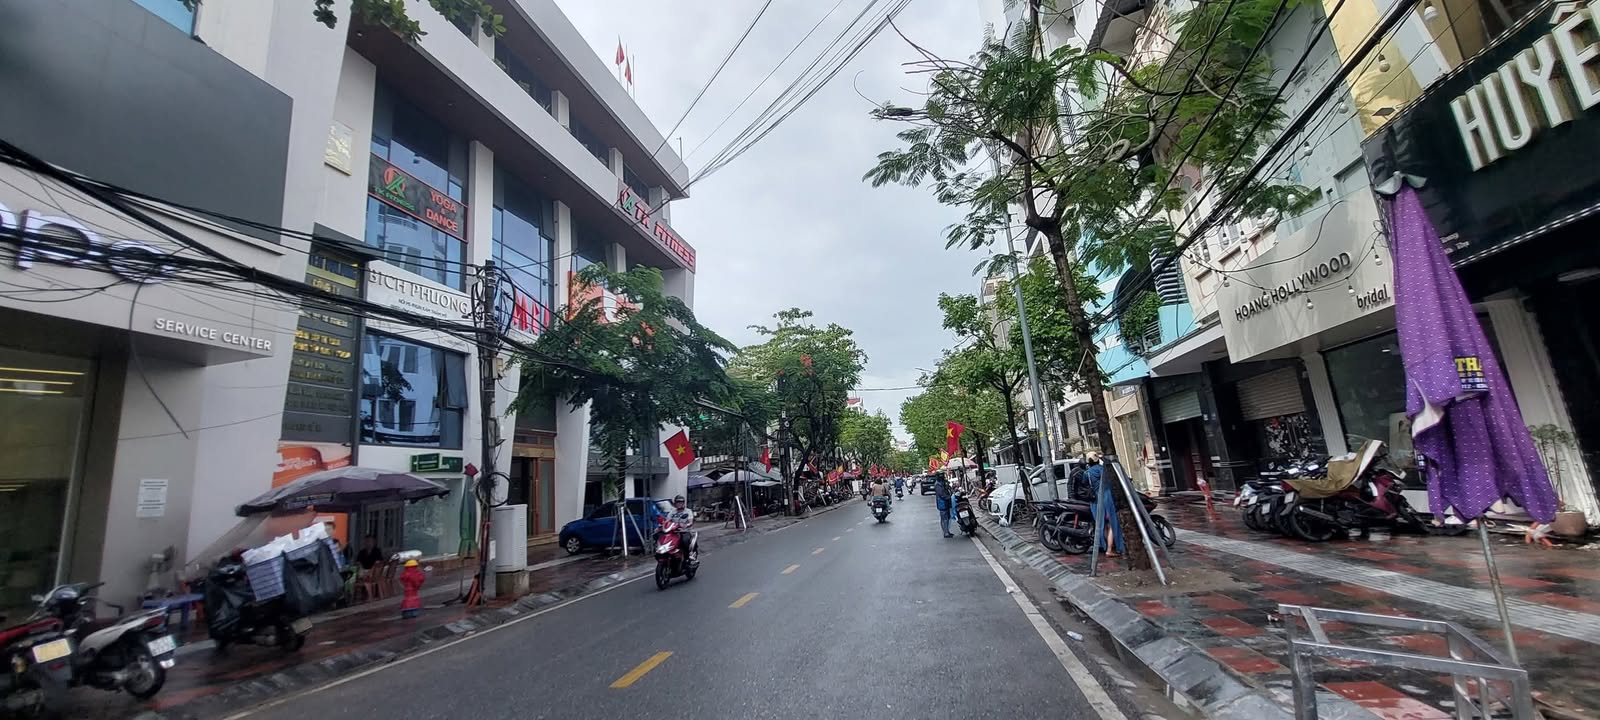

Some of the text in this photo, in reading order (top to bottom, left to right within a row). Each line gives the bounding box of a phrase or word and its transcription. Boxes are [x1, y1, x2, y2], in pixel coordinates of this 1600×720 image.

[1449, 0, 1600, 172] HUYÊ
[430, 190, 457, 213] YOGA
[425, 208, 458, 232] DANCE
[0, 202, 177, 284] po
[1234, 250, 1353, 323] HOANG HOLLYWOOD
[1355, 284, 1390, 311] bridal
[155, 317, 217, 340] SERVICE
[222, 331, 272, 351] CENTER
[1454, 356, 1482, 372] TH
